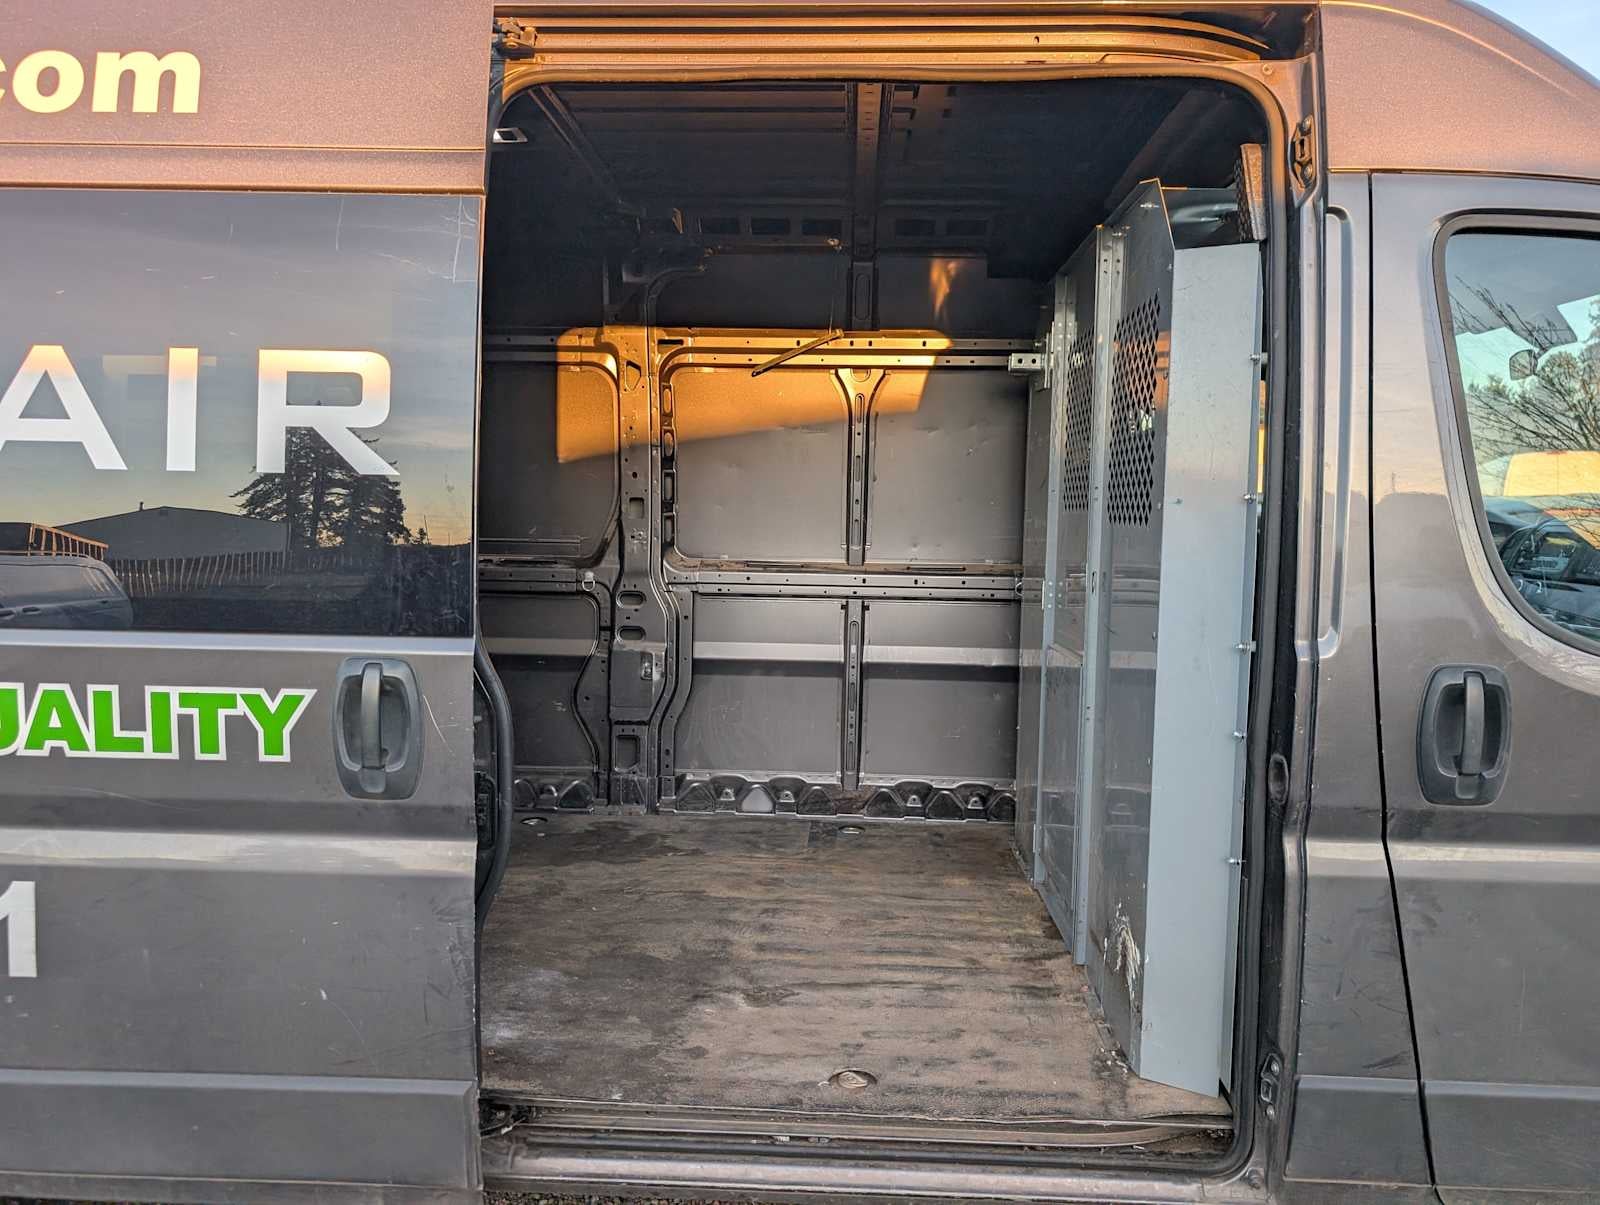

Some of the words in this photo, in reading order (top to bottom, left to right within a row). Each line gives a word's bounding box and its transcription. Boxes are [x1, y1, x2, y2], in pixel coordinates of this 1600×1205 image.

[0, 50, 201, 113] om
[0, 345, 399, 476] AIR
[0, 880, 37, 977] 1
